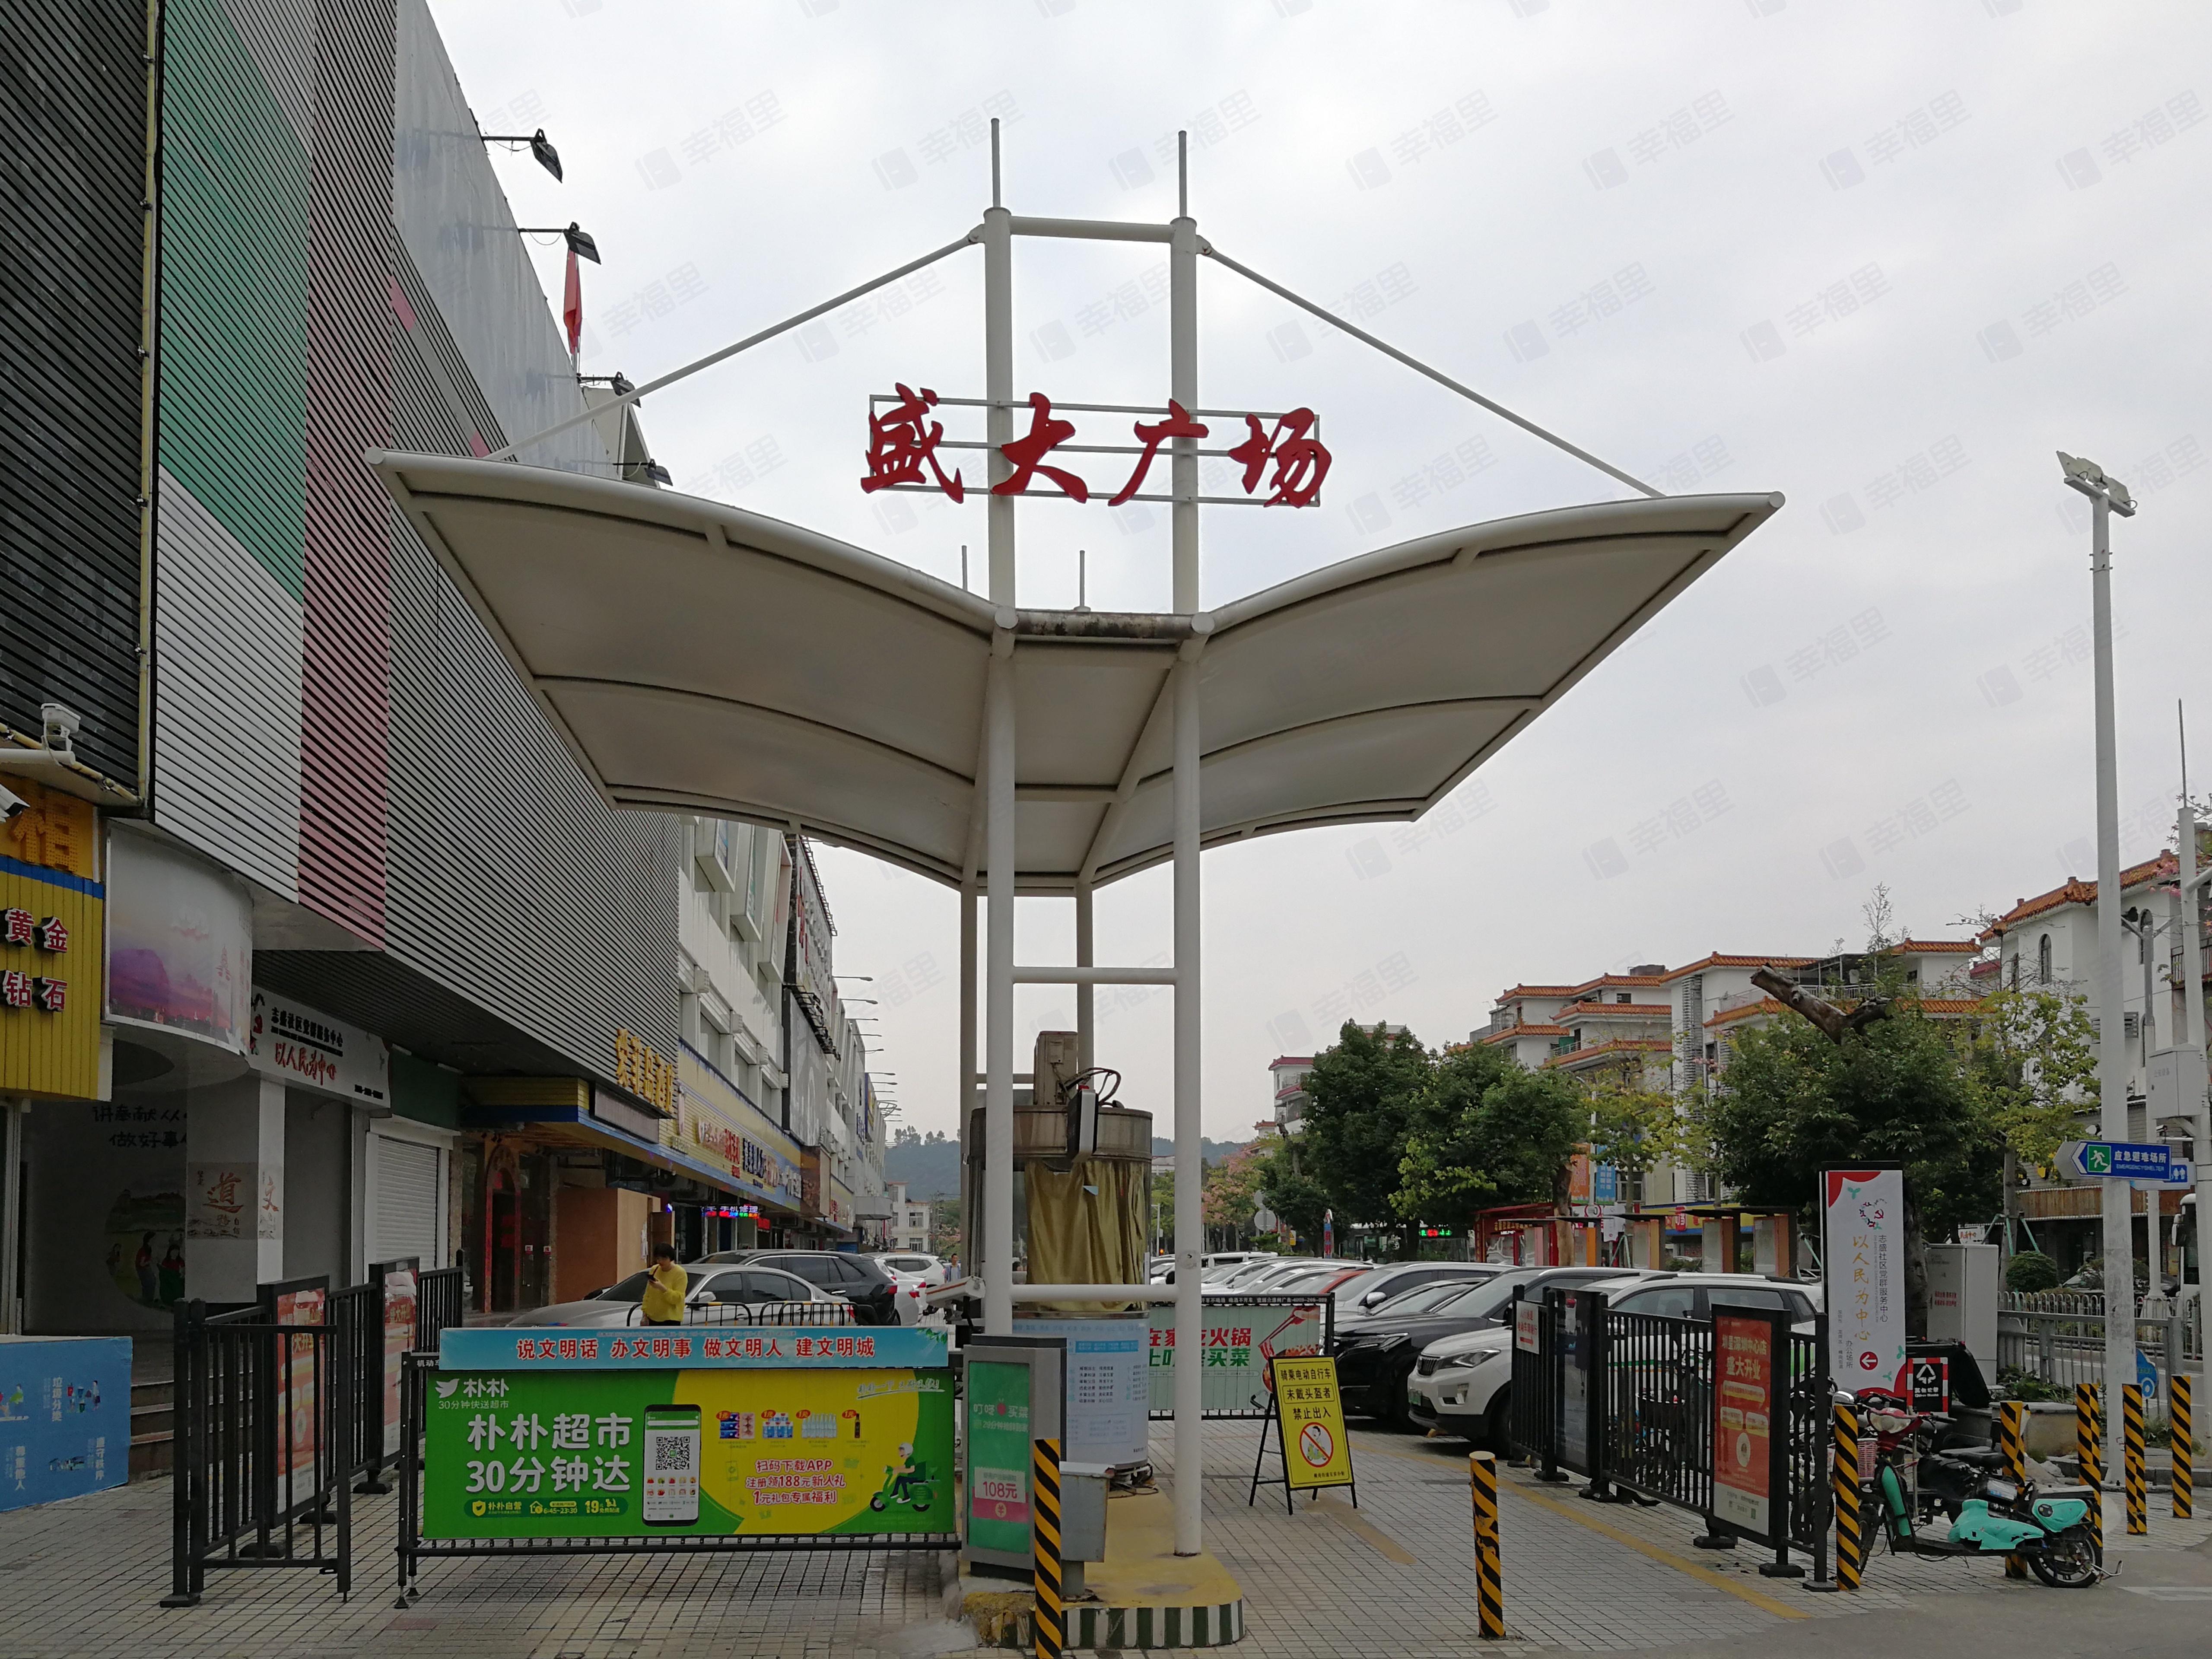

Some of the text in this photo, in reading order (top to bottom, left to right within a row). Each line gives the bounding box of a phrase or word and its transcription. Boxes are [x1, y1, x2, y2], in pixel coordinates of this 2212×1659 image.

[861, 383, 1332, 508] 盛大广场
[6, 908, 69, 952] 黄金
[3, 970, 67, 1011] 钻石
[276, 1043, 336, 1085] 以人民为中心
[109, 1130, 187, 1148] 做好事
[2114, 1150, 2166, 1163] 应急避难场所
[203, 1172, 244, 1213] 道
[1853, 1234, 1870, 1341] 以人民为中心
[1878, 1235, 1888, 1322] 志盛社区党群服务中心
[517, 1337, 875, 1360] 说文明话 办文明事 做文明人 建文明城
[1845, 1340, 1853, 1369] 办公场所
[1281, 1368, 1331, 1381] 骑乘电动自行车
[52, 1376, 63, 1422] 垃圾分类
[463, 1378, 509, 1398] 朴朴
[1287, 1387, 1330, 1400] 未戴头盔者
[439, 1400, 509, 1410] 30分钟快送超市
[1294, 1407, 1331, 1420] 禁止出入
[467, 1413, 632, 1451] 朴朴超市
[465, 1455, 631, 1493] 30分钟达
[756, 1459, 833, 1472] 扫码下载APP
[746, 1475, 846, 1489] 注册领188元新人礼
[983, 1481, 1017, 1499] 108元
[753, 1491, 837, 1505] 1元礼包专属福利
